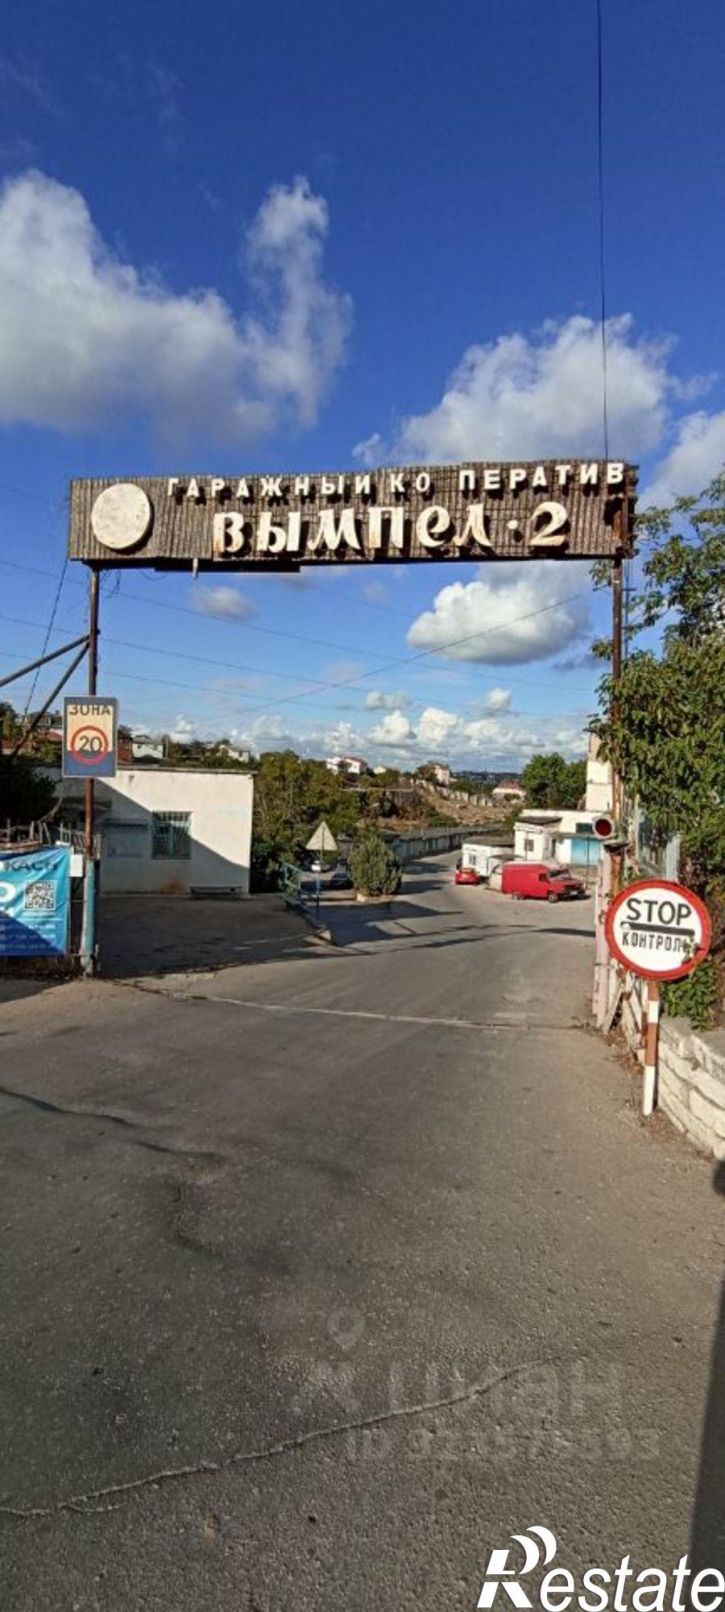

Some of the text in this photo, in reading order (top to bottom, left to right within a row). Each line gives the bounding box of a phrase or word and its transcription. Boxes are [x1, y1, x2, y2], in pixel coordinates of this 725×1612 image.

[69, 703, 111, 716] ЗОНА
[79, 735, 103, 753] 20
[626, 897, 692, 926] STOP
[622, 932, 689, 953] КОНТРОЛ
